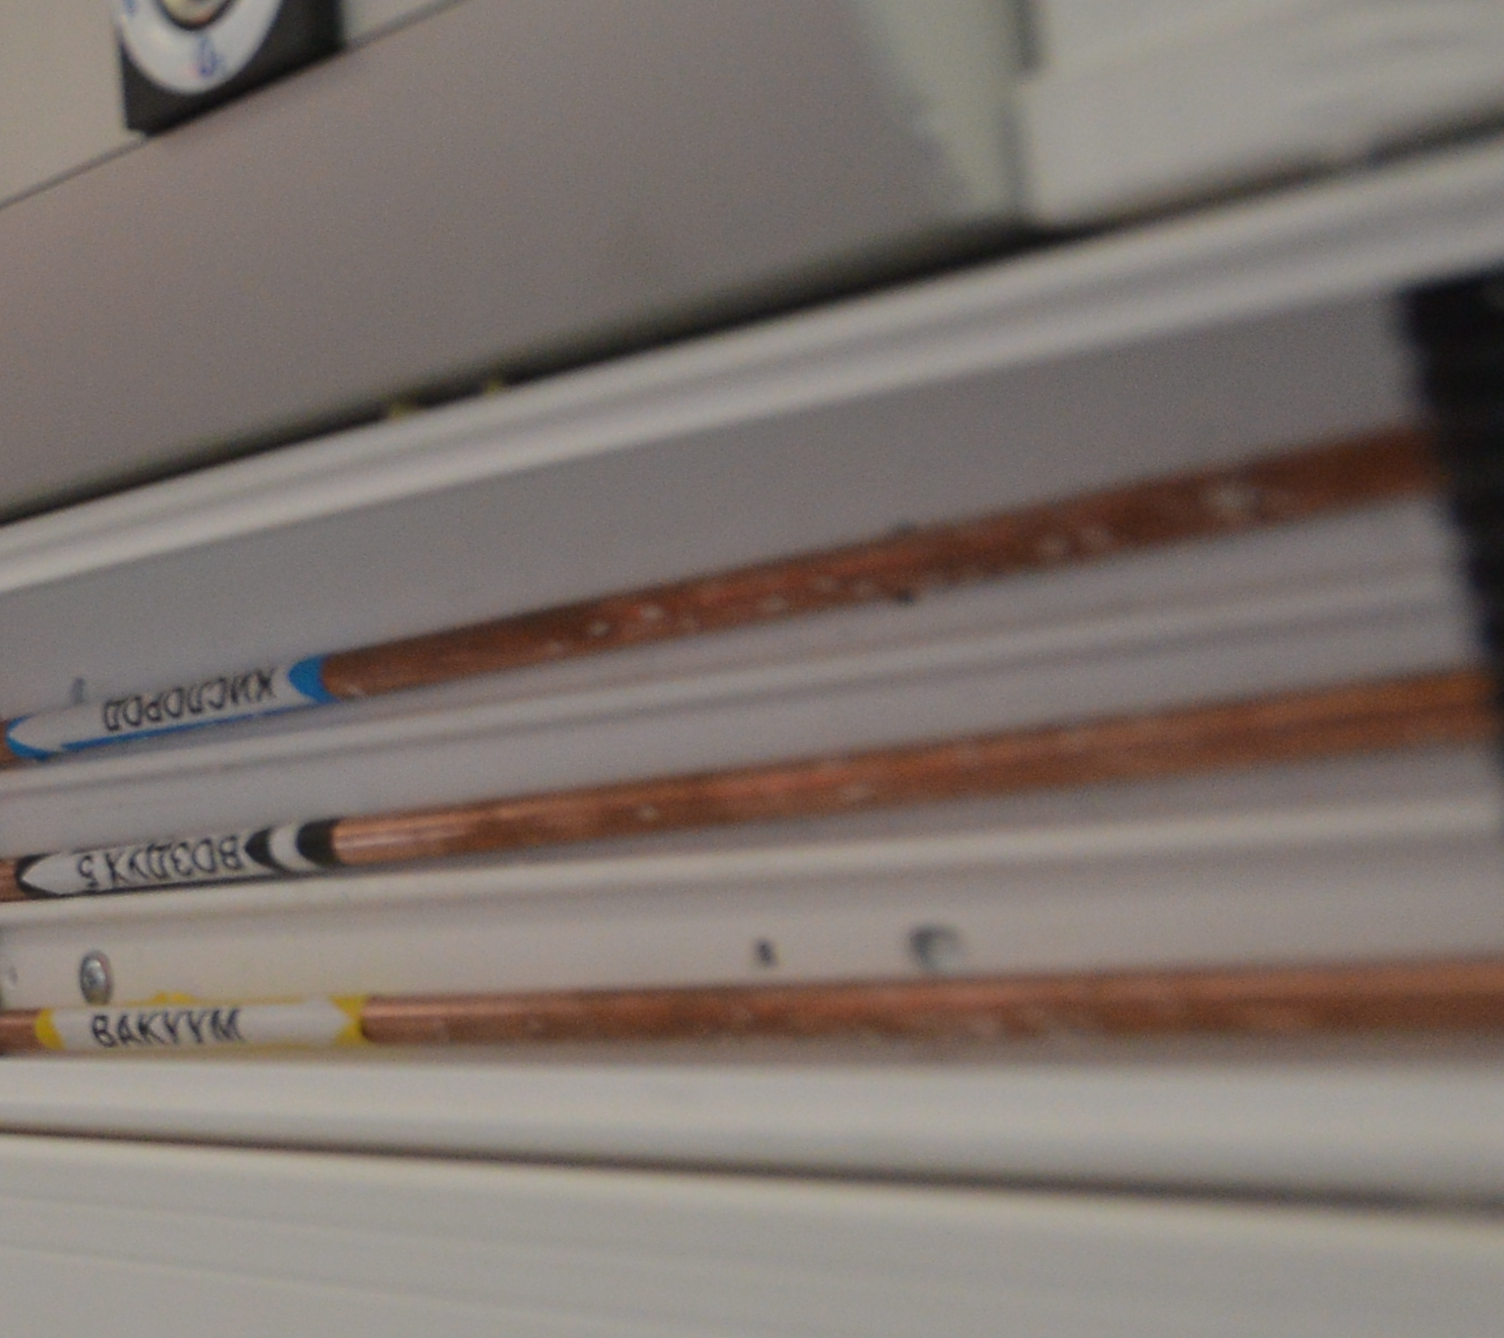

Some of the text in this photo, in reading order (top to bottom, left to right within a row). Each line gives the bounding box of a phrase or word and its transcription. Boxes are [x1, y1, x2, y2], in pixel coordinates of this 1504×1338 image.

[103, 667, 277, 731] КИСЛОРОД
[108, 833, 242, 885] ВОЗДУХ
[91, 1008, 245, 1049] ВАКУУМ
